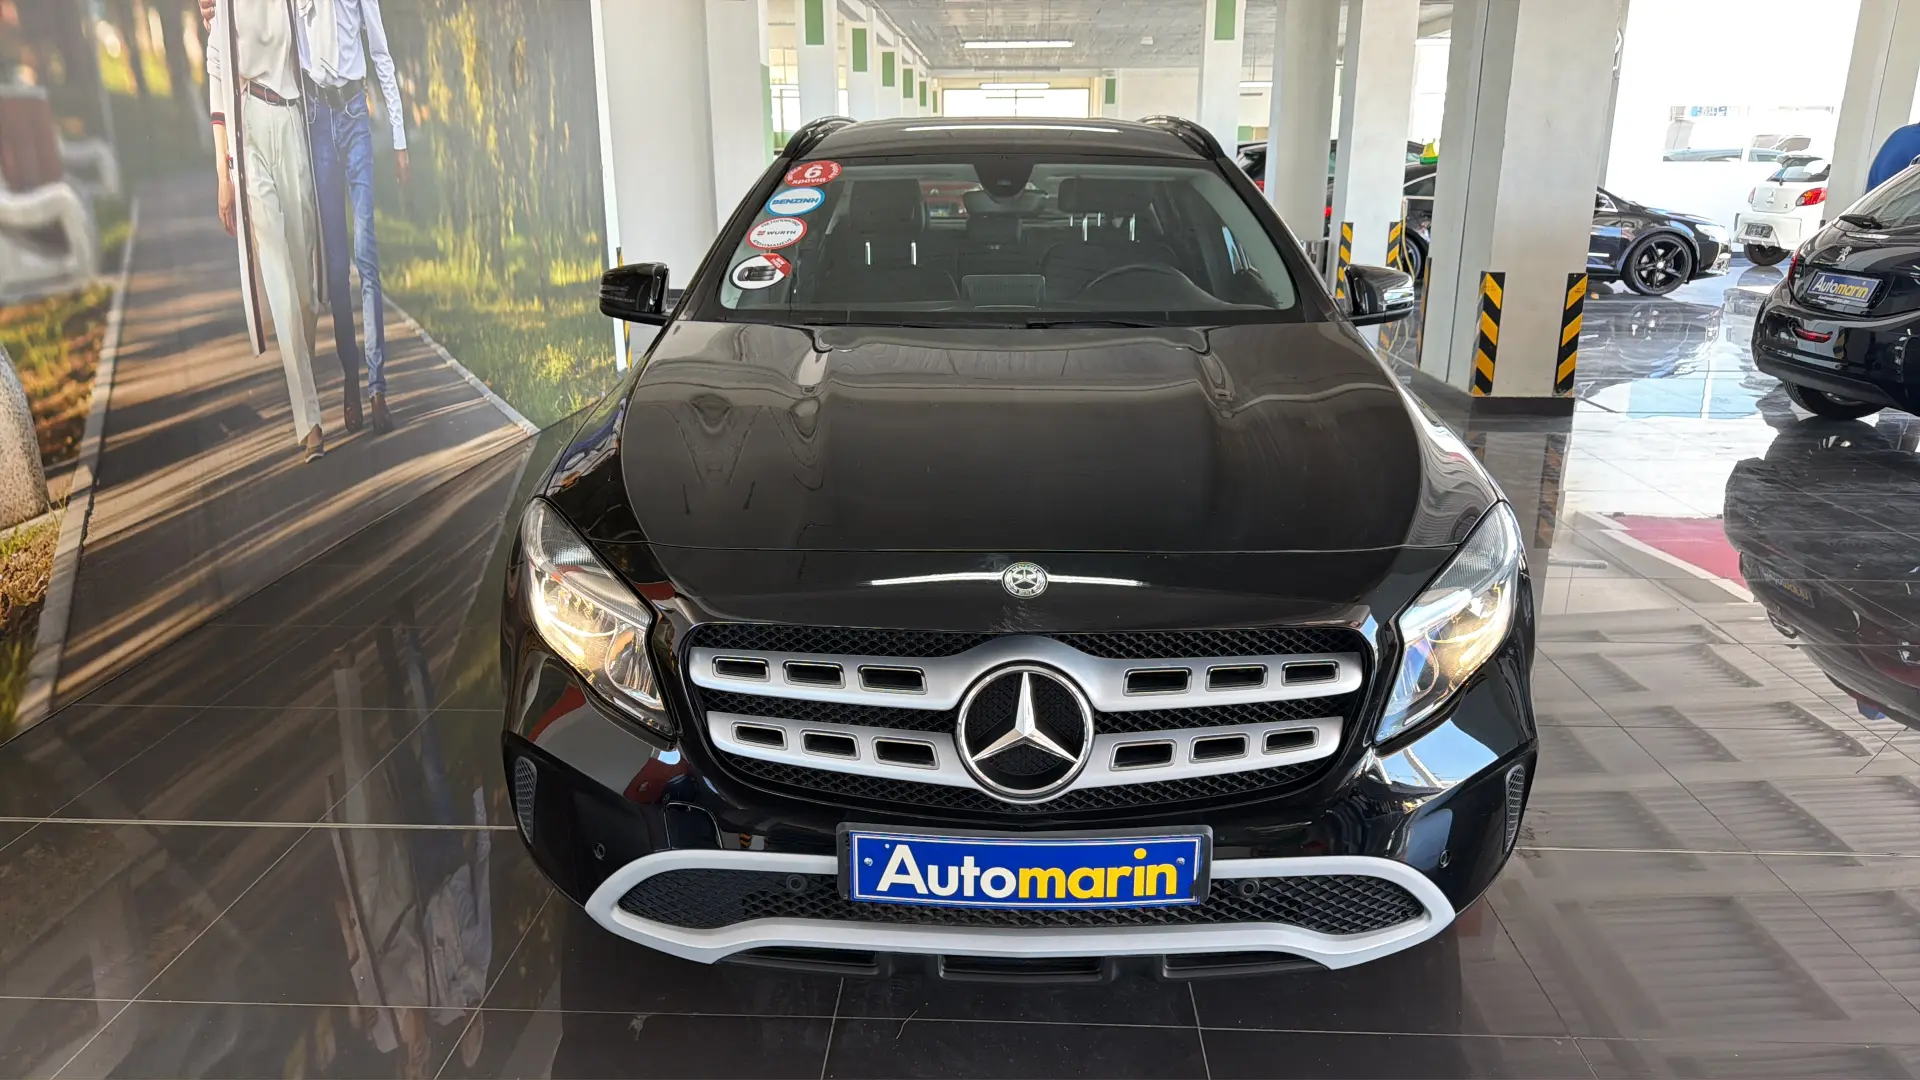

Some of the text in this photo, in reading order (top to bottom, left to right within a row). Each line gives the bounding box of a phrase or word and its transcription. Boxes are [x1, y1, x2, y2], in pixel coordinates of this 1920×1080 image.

[804, 165, 823, 178] 6
[1812, 275, 1869, 298] Automarin
[876, 844, 1177, 899] Automarin
